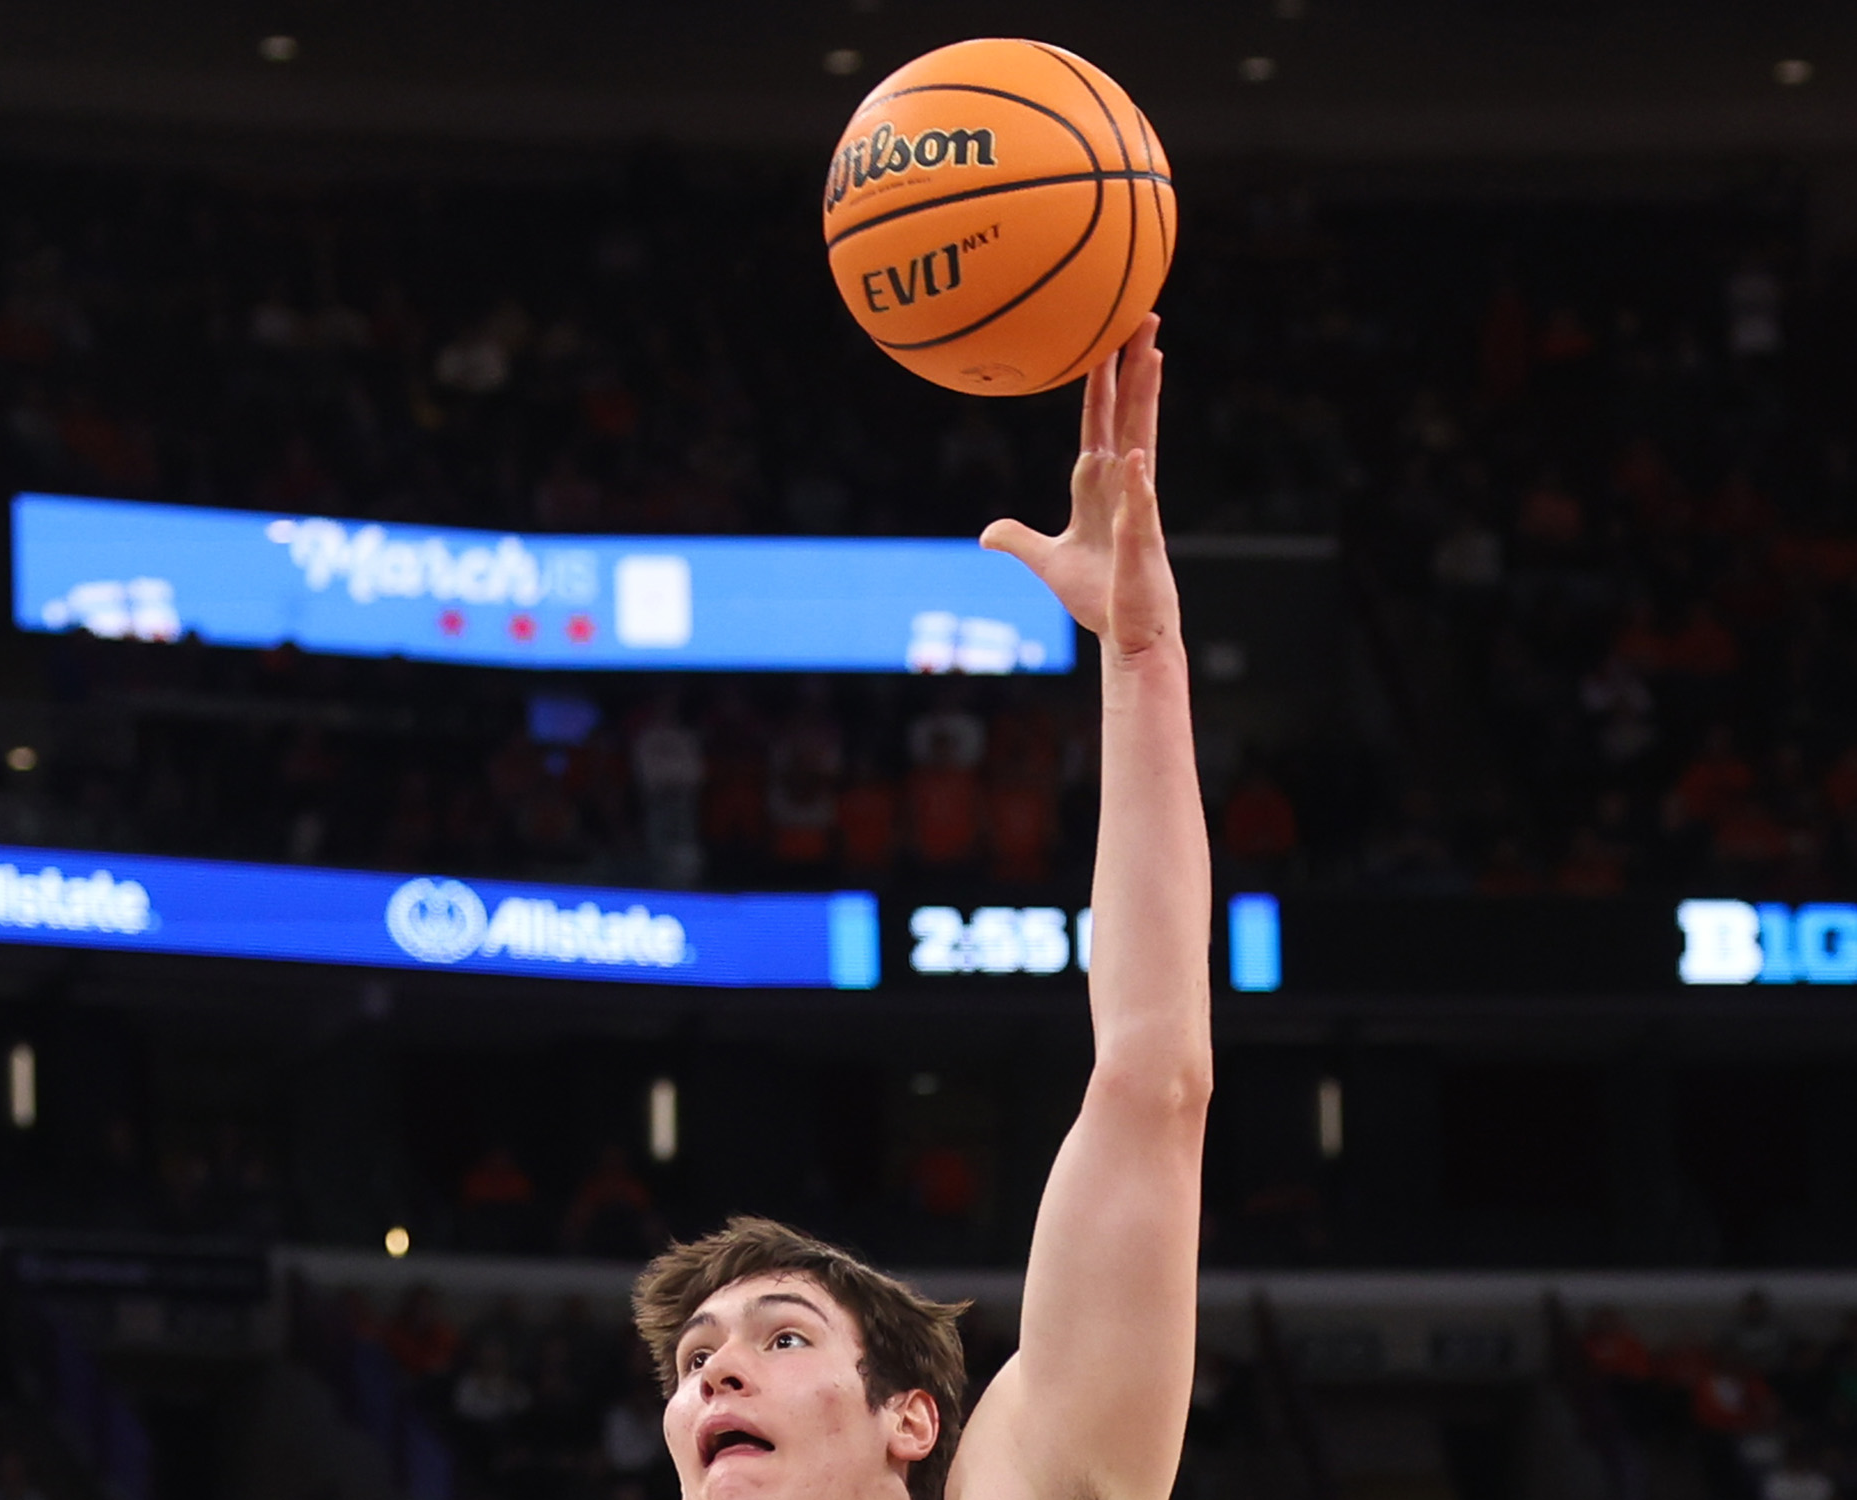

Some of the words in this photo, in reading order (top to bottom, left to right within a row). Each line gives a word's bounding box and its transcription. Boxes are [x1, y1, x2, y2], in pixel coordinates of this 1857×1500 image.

[961, 222, 1001, 254] NXT
[481, 897, 687, 968] Allstate
[910, 904, 1070, 975] 2:55
